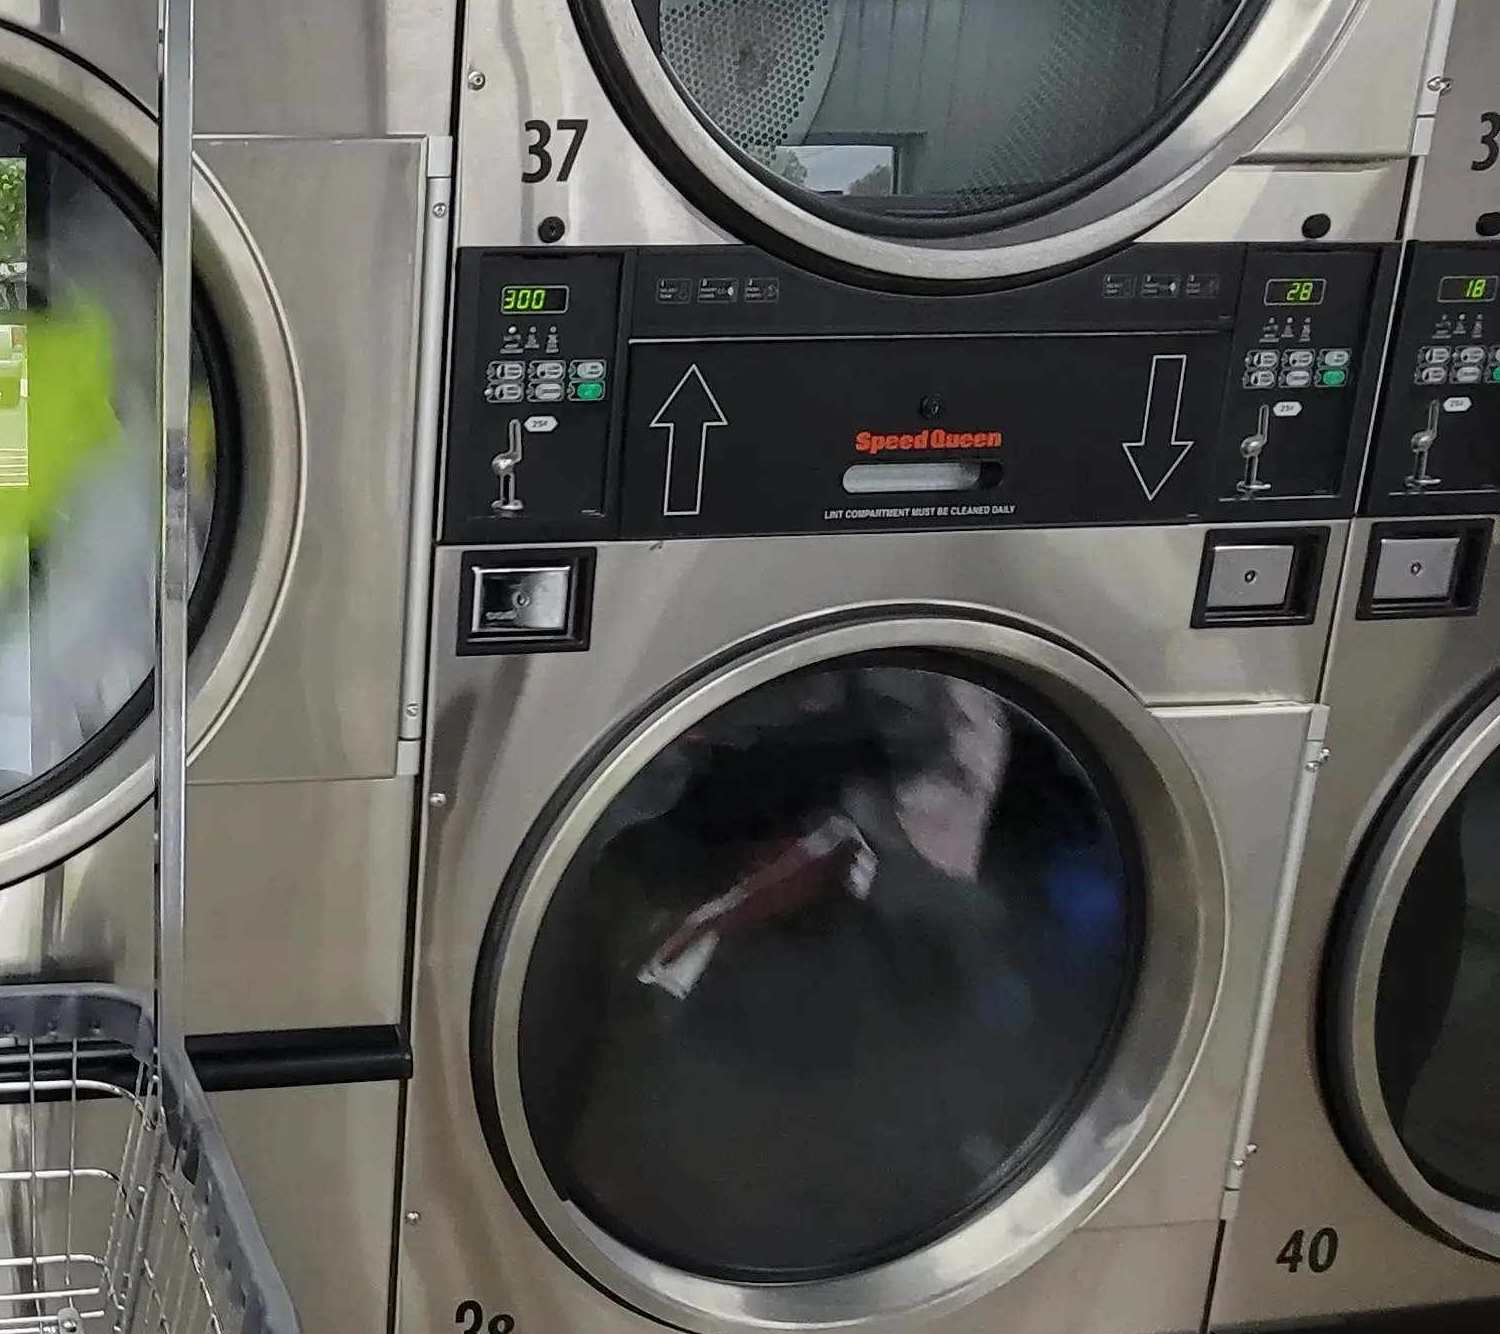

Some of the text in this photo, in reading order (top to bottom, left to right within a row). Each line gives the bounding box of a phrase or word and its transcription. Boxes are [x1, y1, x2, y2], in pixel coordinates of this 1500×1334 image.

[521, 119, 588, 183] 37
[1287, 282, 1313, 301] 28
[1465, 279, 1486, 298] 18
[503, 289, 545, 310] 300
[855, 428, 1001, 454] Speed Queen
[824, 504, 1016, 520] LINT COMPARTMENT MUST BE CLEANED DAILY
[1276, 1227, 1338, 1273] 40
